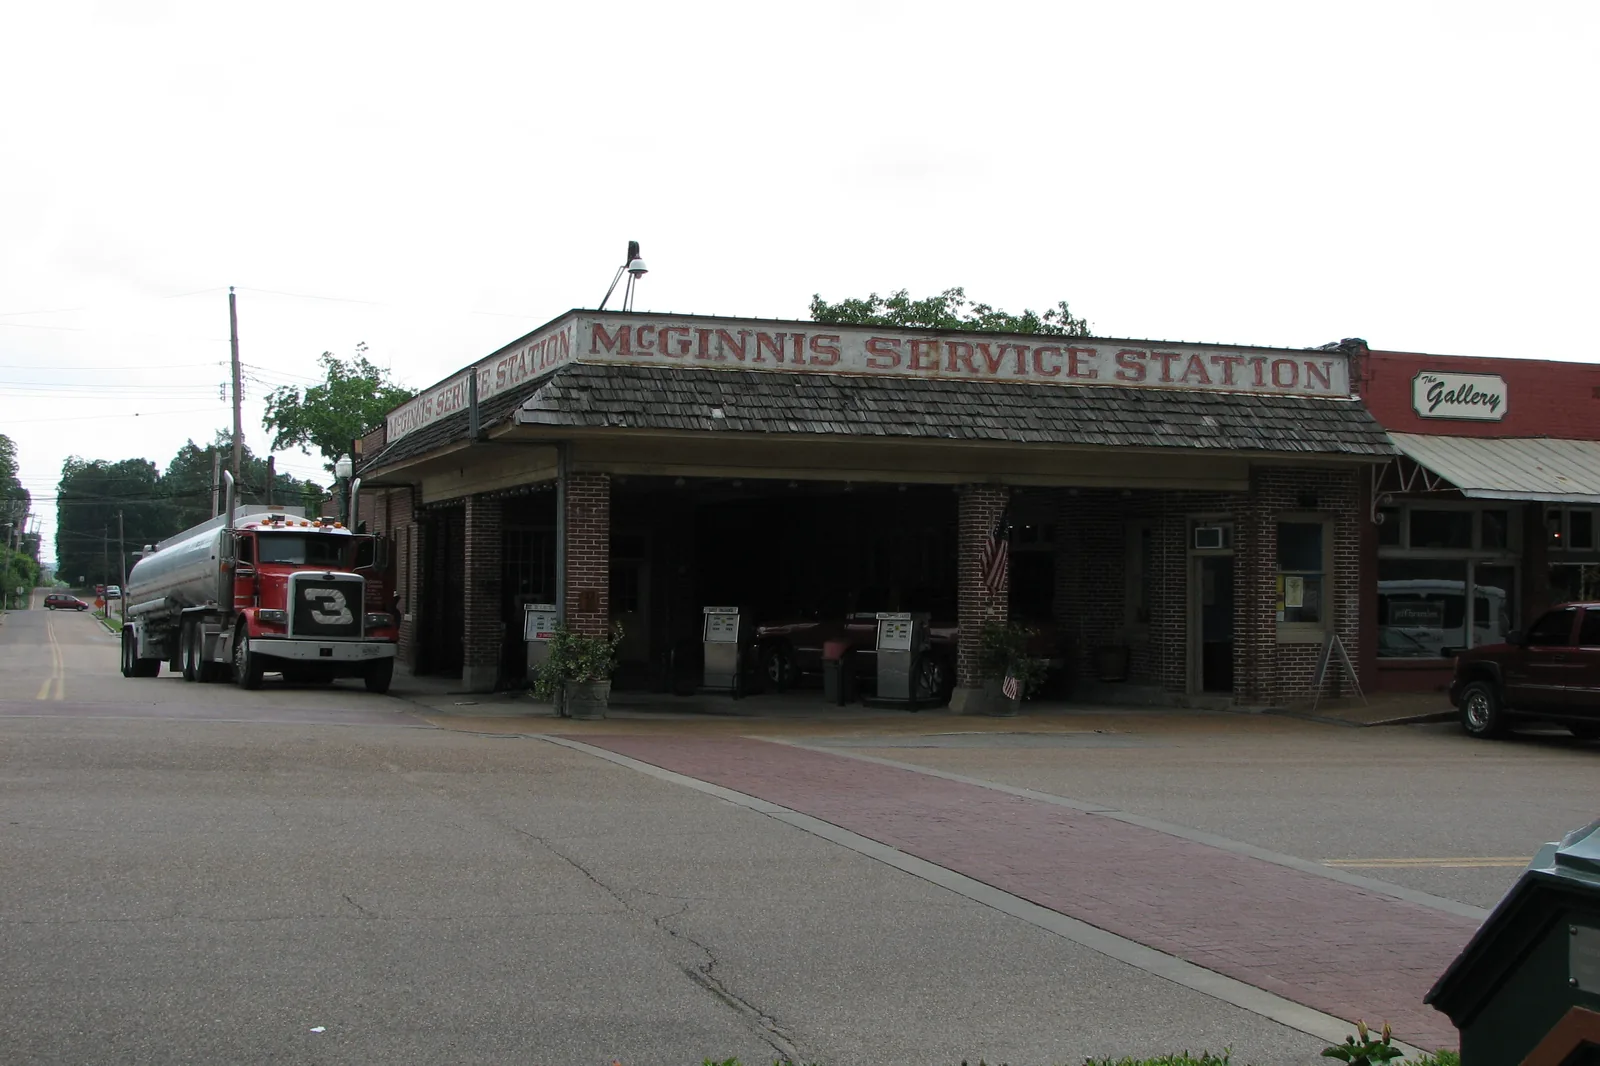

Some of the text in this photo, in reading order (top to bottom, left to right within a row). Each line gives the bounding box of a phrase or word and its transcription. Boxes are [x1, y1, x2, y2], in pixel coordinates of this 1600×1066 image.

[496, 326, 572, 389] STATION
[865, 336, 1097, 379] SERVICE
[1115, 349, 1333, 390] STATION
[1421, 375, 1437, 384] The
[1427, 381, 1501, 413] Gallery
[304, 588, 353, 625] 3
